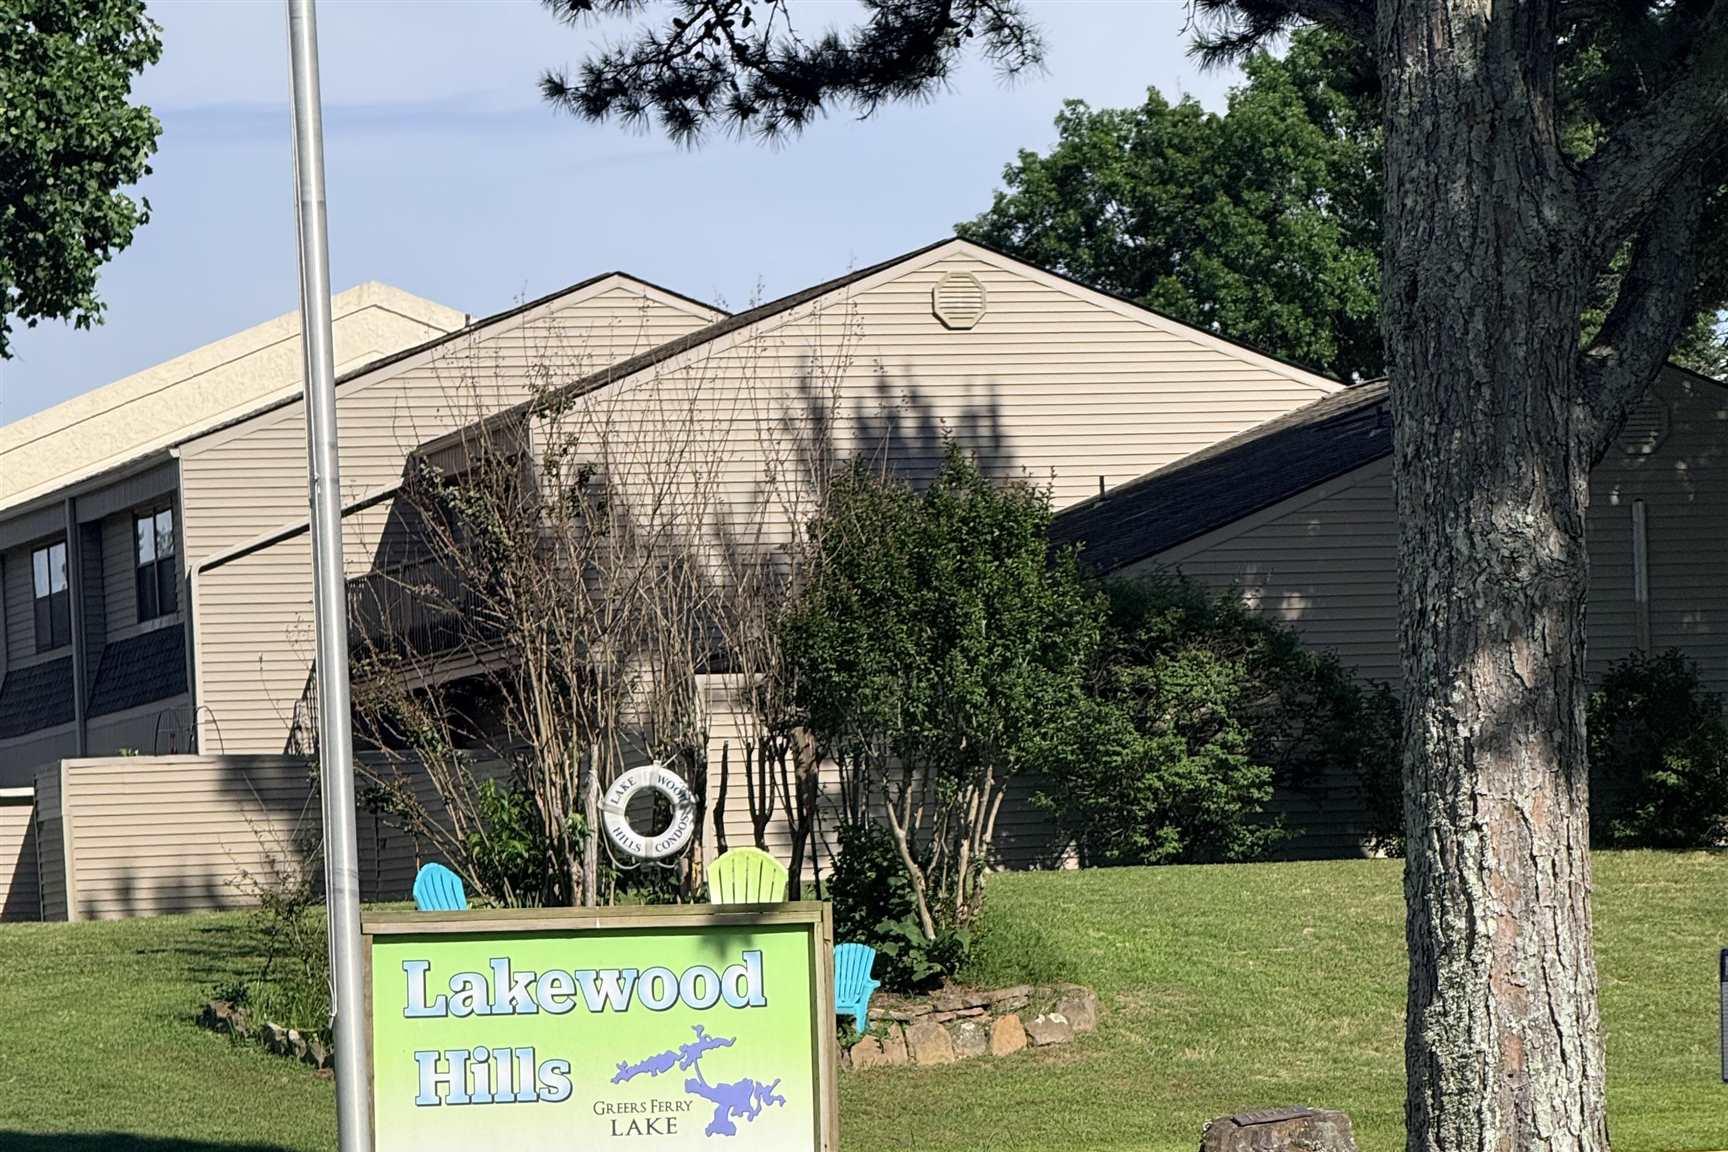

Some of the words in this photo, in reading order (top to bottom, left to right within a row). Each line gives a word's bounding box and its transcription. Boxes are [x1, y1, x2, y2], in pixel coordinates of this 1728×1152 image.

[610, 776, 637, 805] LAKE
[612, 826, 641, 853] HILLS
[402, 950, 767, 1018] Lakewood
[414, 1046, 573, 1106] Hills
[593, 1100, 647, 1115] GREERS
[650, 1099, 693, 1113] FERRY
[611, 1117, 678, 1136] LAKE
